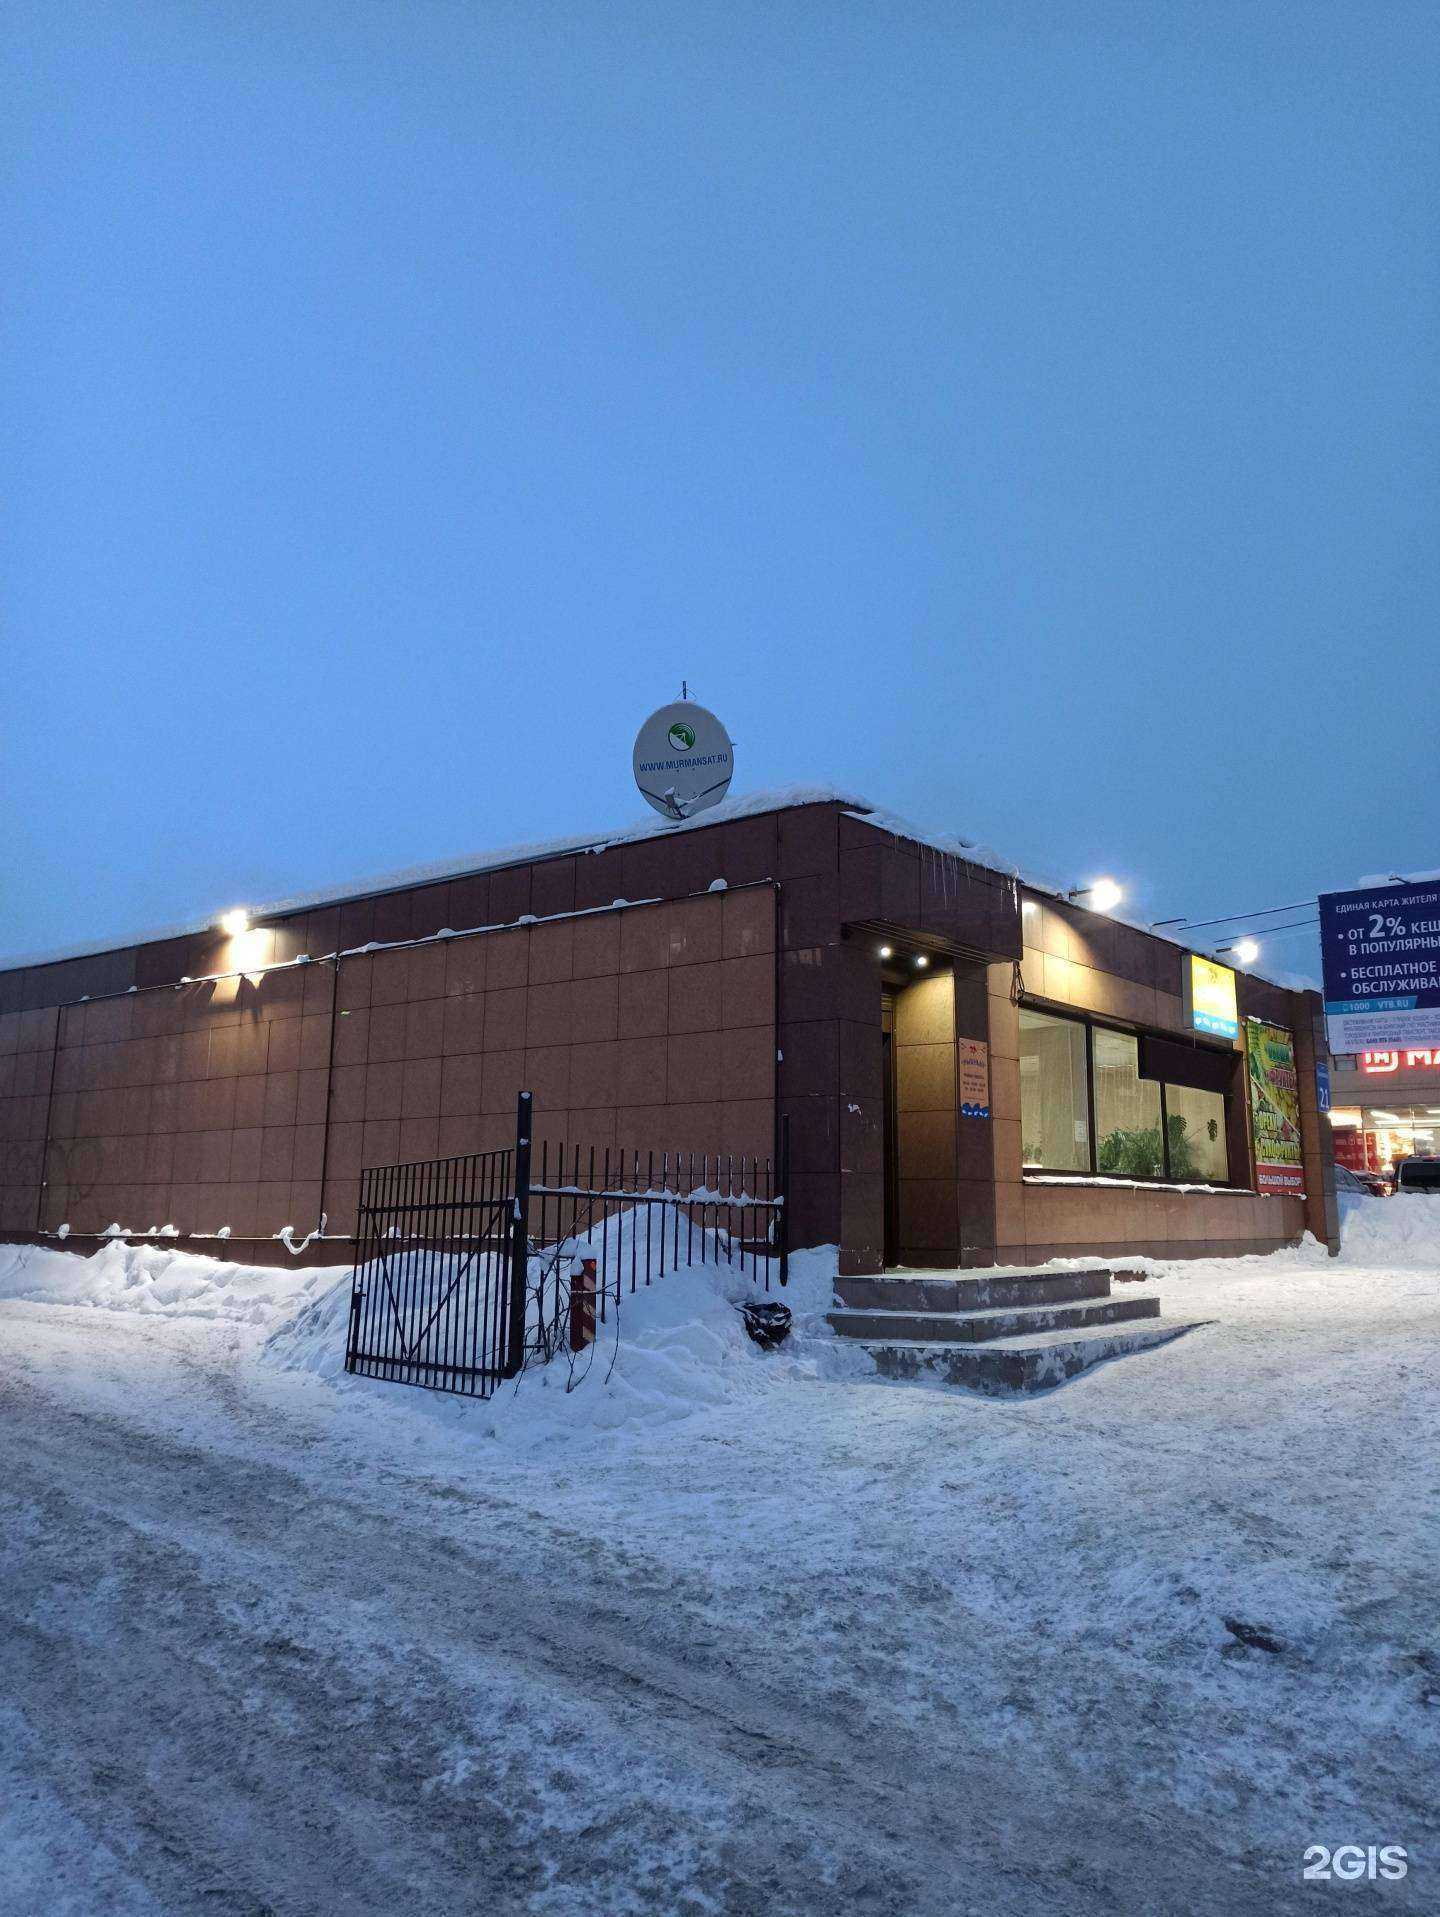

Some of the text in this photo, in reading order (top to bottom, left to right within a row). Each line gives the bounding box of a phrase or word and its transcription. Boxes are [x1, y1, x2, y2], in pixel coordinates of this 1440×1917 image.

[640, 753, 728, 771] WWW.MURMANSAT.RU
[1335, 893, 1438, 913] ЕДИНАЯ КАРТА ЖИТЕЛЯ
[1348, 928, 1365, 940] ОТ
[1368, 914, 1406, 938] 2%
[1349, 944, 1357, 956] В
[1351, 961, 1436, 979] БЕСПЛАТНОЕ
[1352, 977, 1440, 994] ОБСЛУЖИВА
[1319, 1087, 1330, 1109] 21
